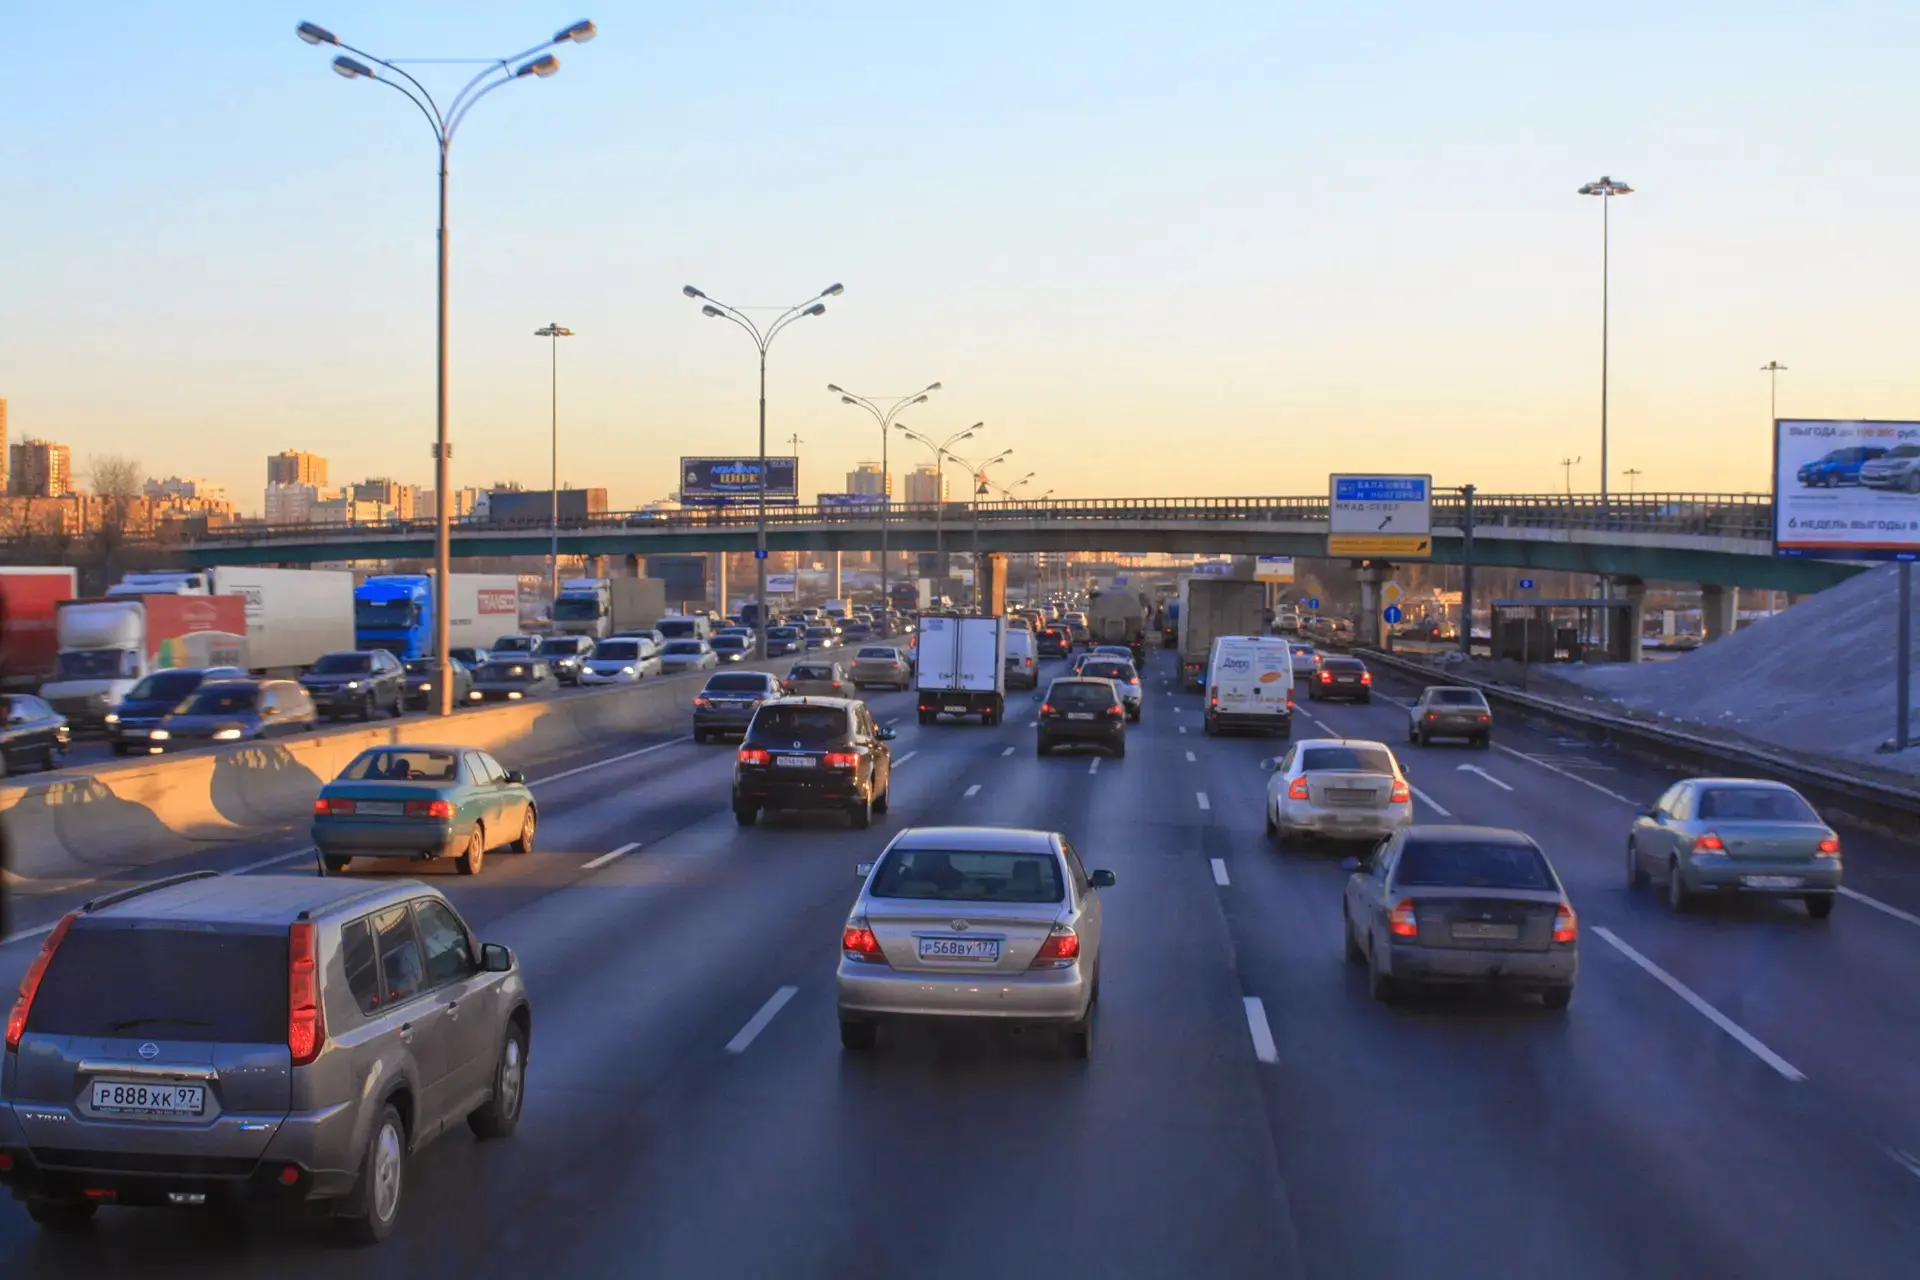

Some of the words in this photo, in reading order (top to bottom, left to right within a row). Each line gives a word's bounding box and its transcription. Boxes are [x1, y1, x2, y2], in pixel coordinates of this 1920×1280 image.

[1789, 427, 1836, 437] ВЫГОДА
[1788, 517, 1798, 529] 6
[1800, 519, 1848, 531] НЕДЕЛЬ
[1850, 519, 1907, 532] ВЫГОДЫ
[178, 1089, 196, 1104] 97
